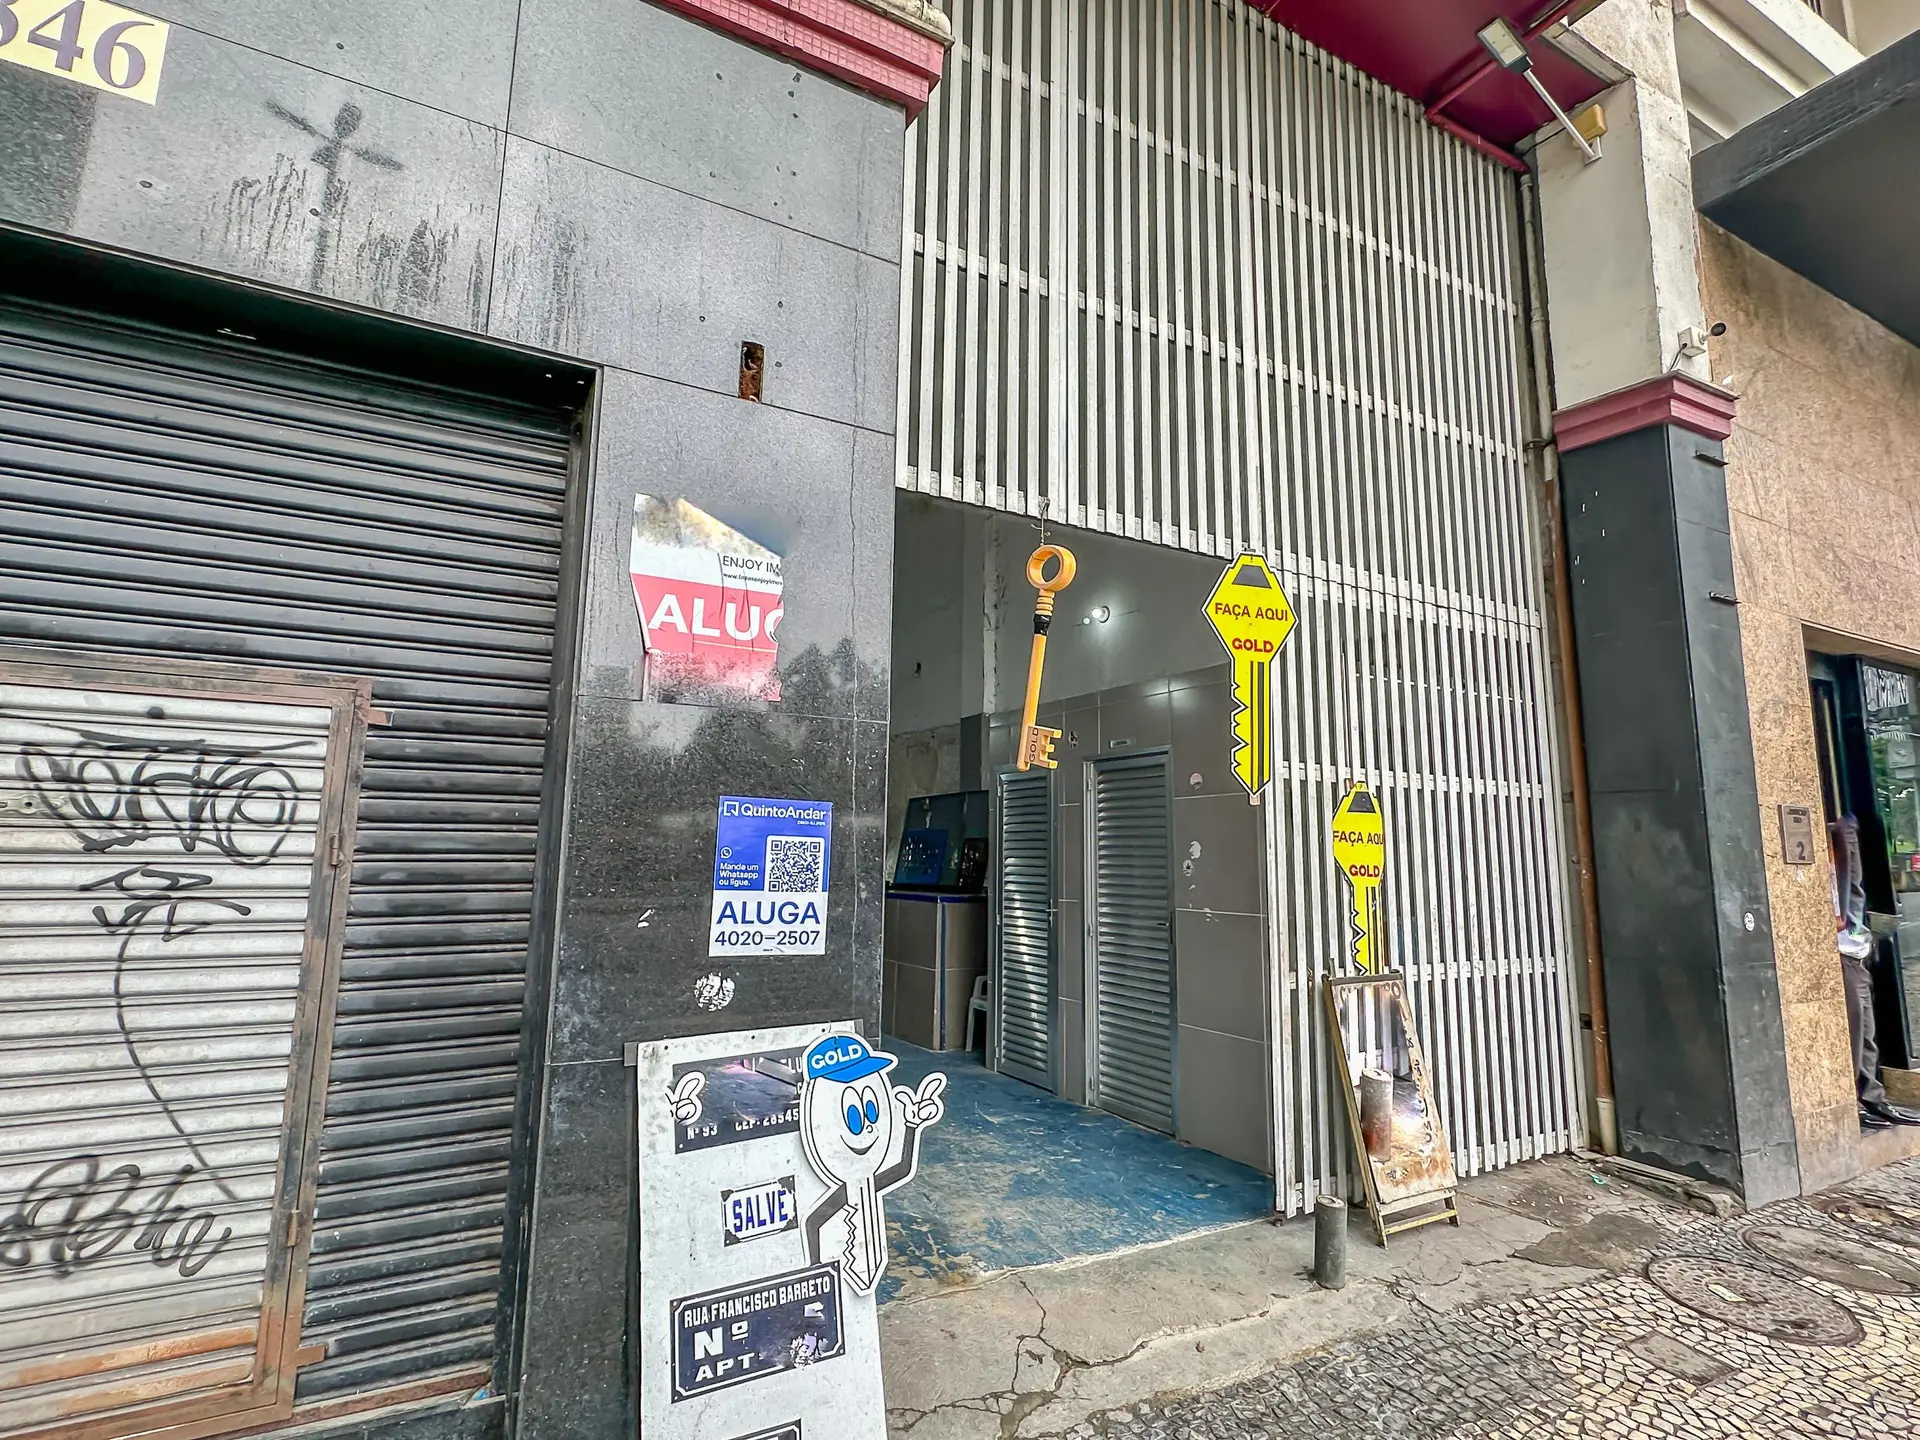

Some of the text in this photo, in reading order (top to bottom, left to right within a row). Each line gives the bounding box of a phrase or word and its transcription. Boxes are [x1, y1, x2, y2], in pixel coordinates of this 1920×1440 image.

[722, 555, 763, 571] ENJOY
[1214, 602, 1288, 621] FAÇA AQUI
[1232, 637, 1274, 653] GOLD
[1029, 727, 1039, 763] GOLD
[741, 802, 827, 820] QuintoAndar
[1332, 830, 1364, 847] FAÇA
[1796, 840, 1806, 861] 2
[720, 862, 746, 871] Mande
[1348, 864, 1380, 878] GOLD
[716, 901, 821, 925] ALUGA
[714, 930, 820, 946] 4020-2507
[811, 1044, 863, 1070] GOLD
[732, 1189, 788, 1233] SALVE
[684, 1305, 711, 1329] RUA
[711, 1288, 777, 1322] FRANCISCO
[779, 1275, 831, 1305] BARRETO
